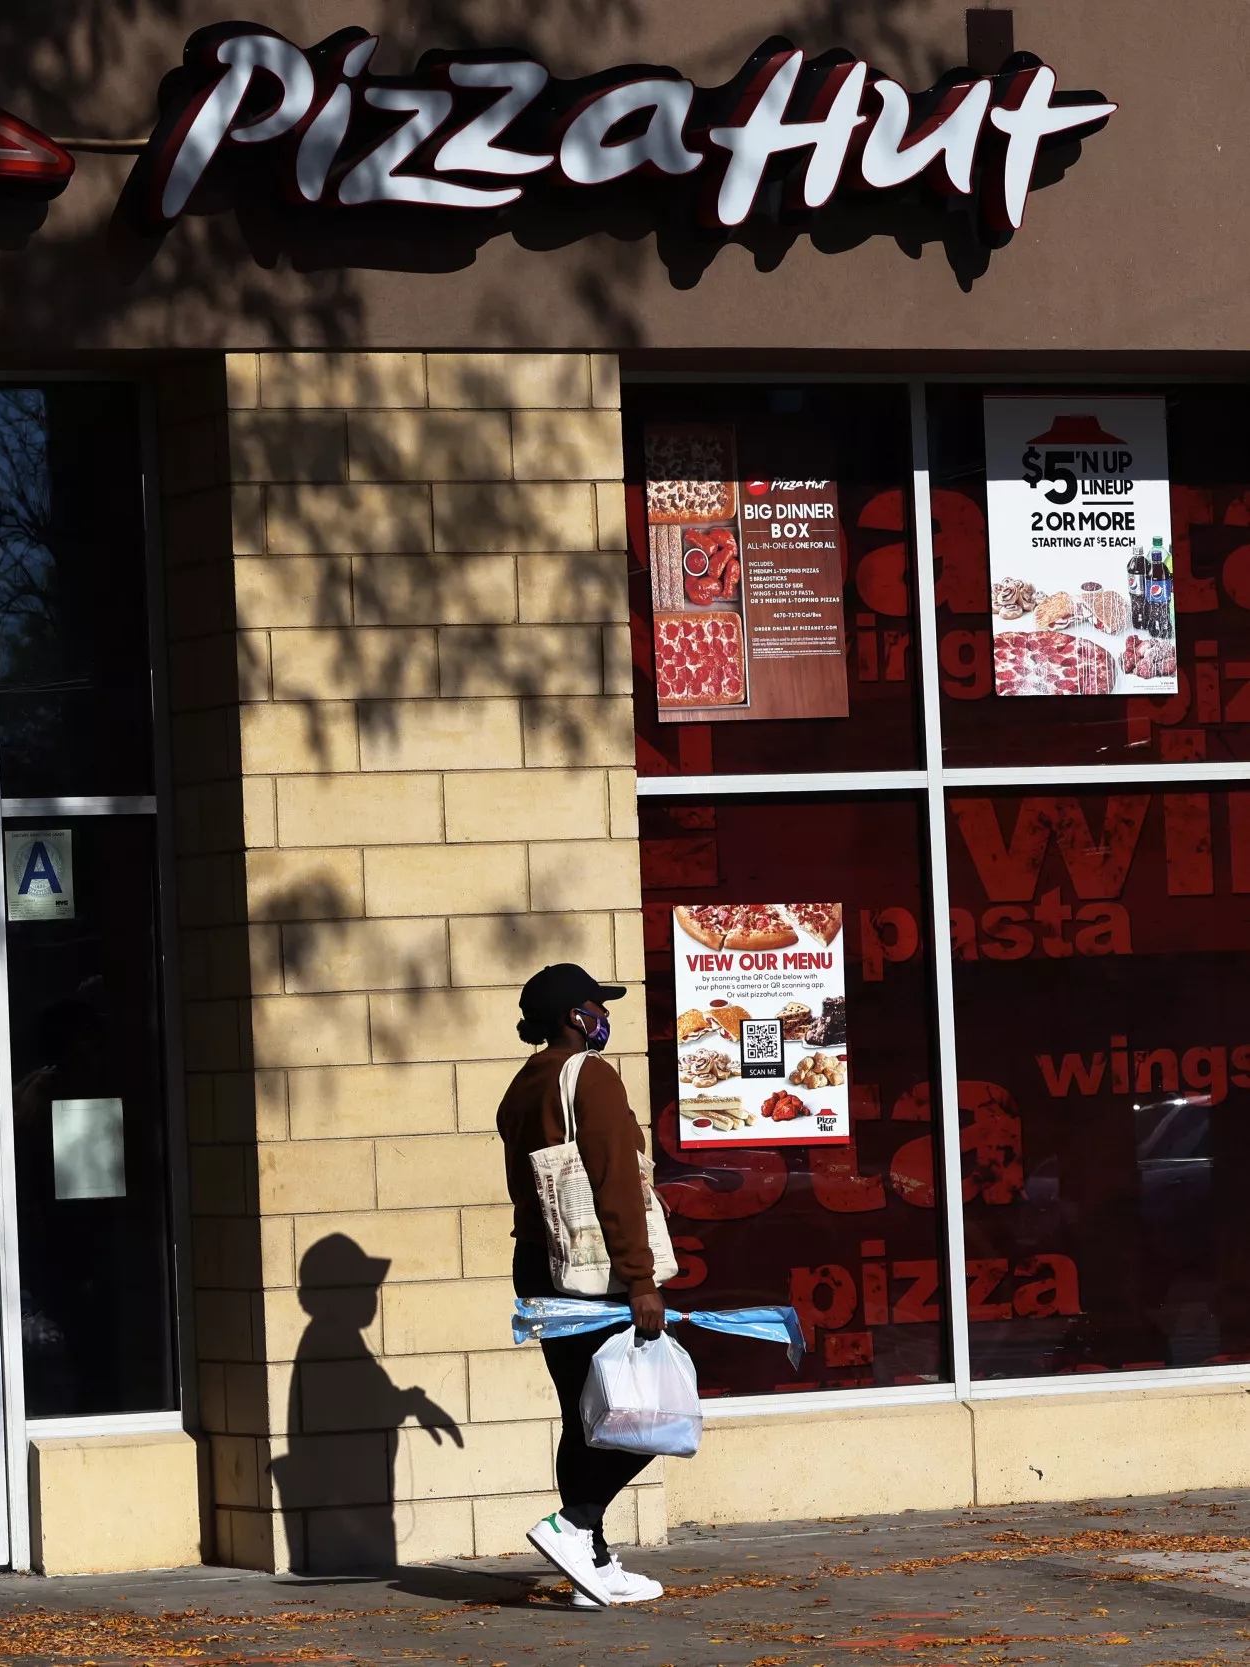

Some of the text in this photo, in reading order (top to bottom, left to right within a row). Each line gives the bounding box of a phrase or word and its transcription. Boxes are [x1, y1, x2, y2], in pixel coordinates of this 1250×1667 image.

[161, 33, 1120, 230] Pizza Hut
[1103, 451, 1133, 473] UP
[1081, 480, 1134, 495] LINEUP
[744, 503, 834, 520] BIG DINNER
[1031, 511, 1135, 531] 2 OR MORE
[771, 523, 810, 538] BOX
[824, 541, 836, 549] ALL
[1032, 536, 1136, 547] STARTING AT $5 EACH
[18, 841, 63, 895] A
[859, 886, 1134, 982] pasta
[686, 952, 833, 972] VIEW OUR MENU
[710, 983, 735, 991] phone's
[781, 982, 810, 990] scanning
[816, 1116, 837, 1125] Pizza
[817, 1124, 834, 1132] Hut
[545, 1174, 556, 1204] ALBERT
[550, 1207, 561, 1239] JOSEPH
[788, 1240, 1083, 1353] pizza
